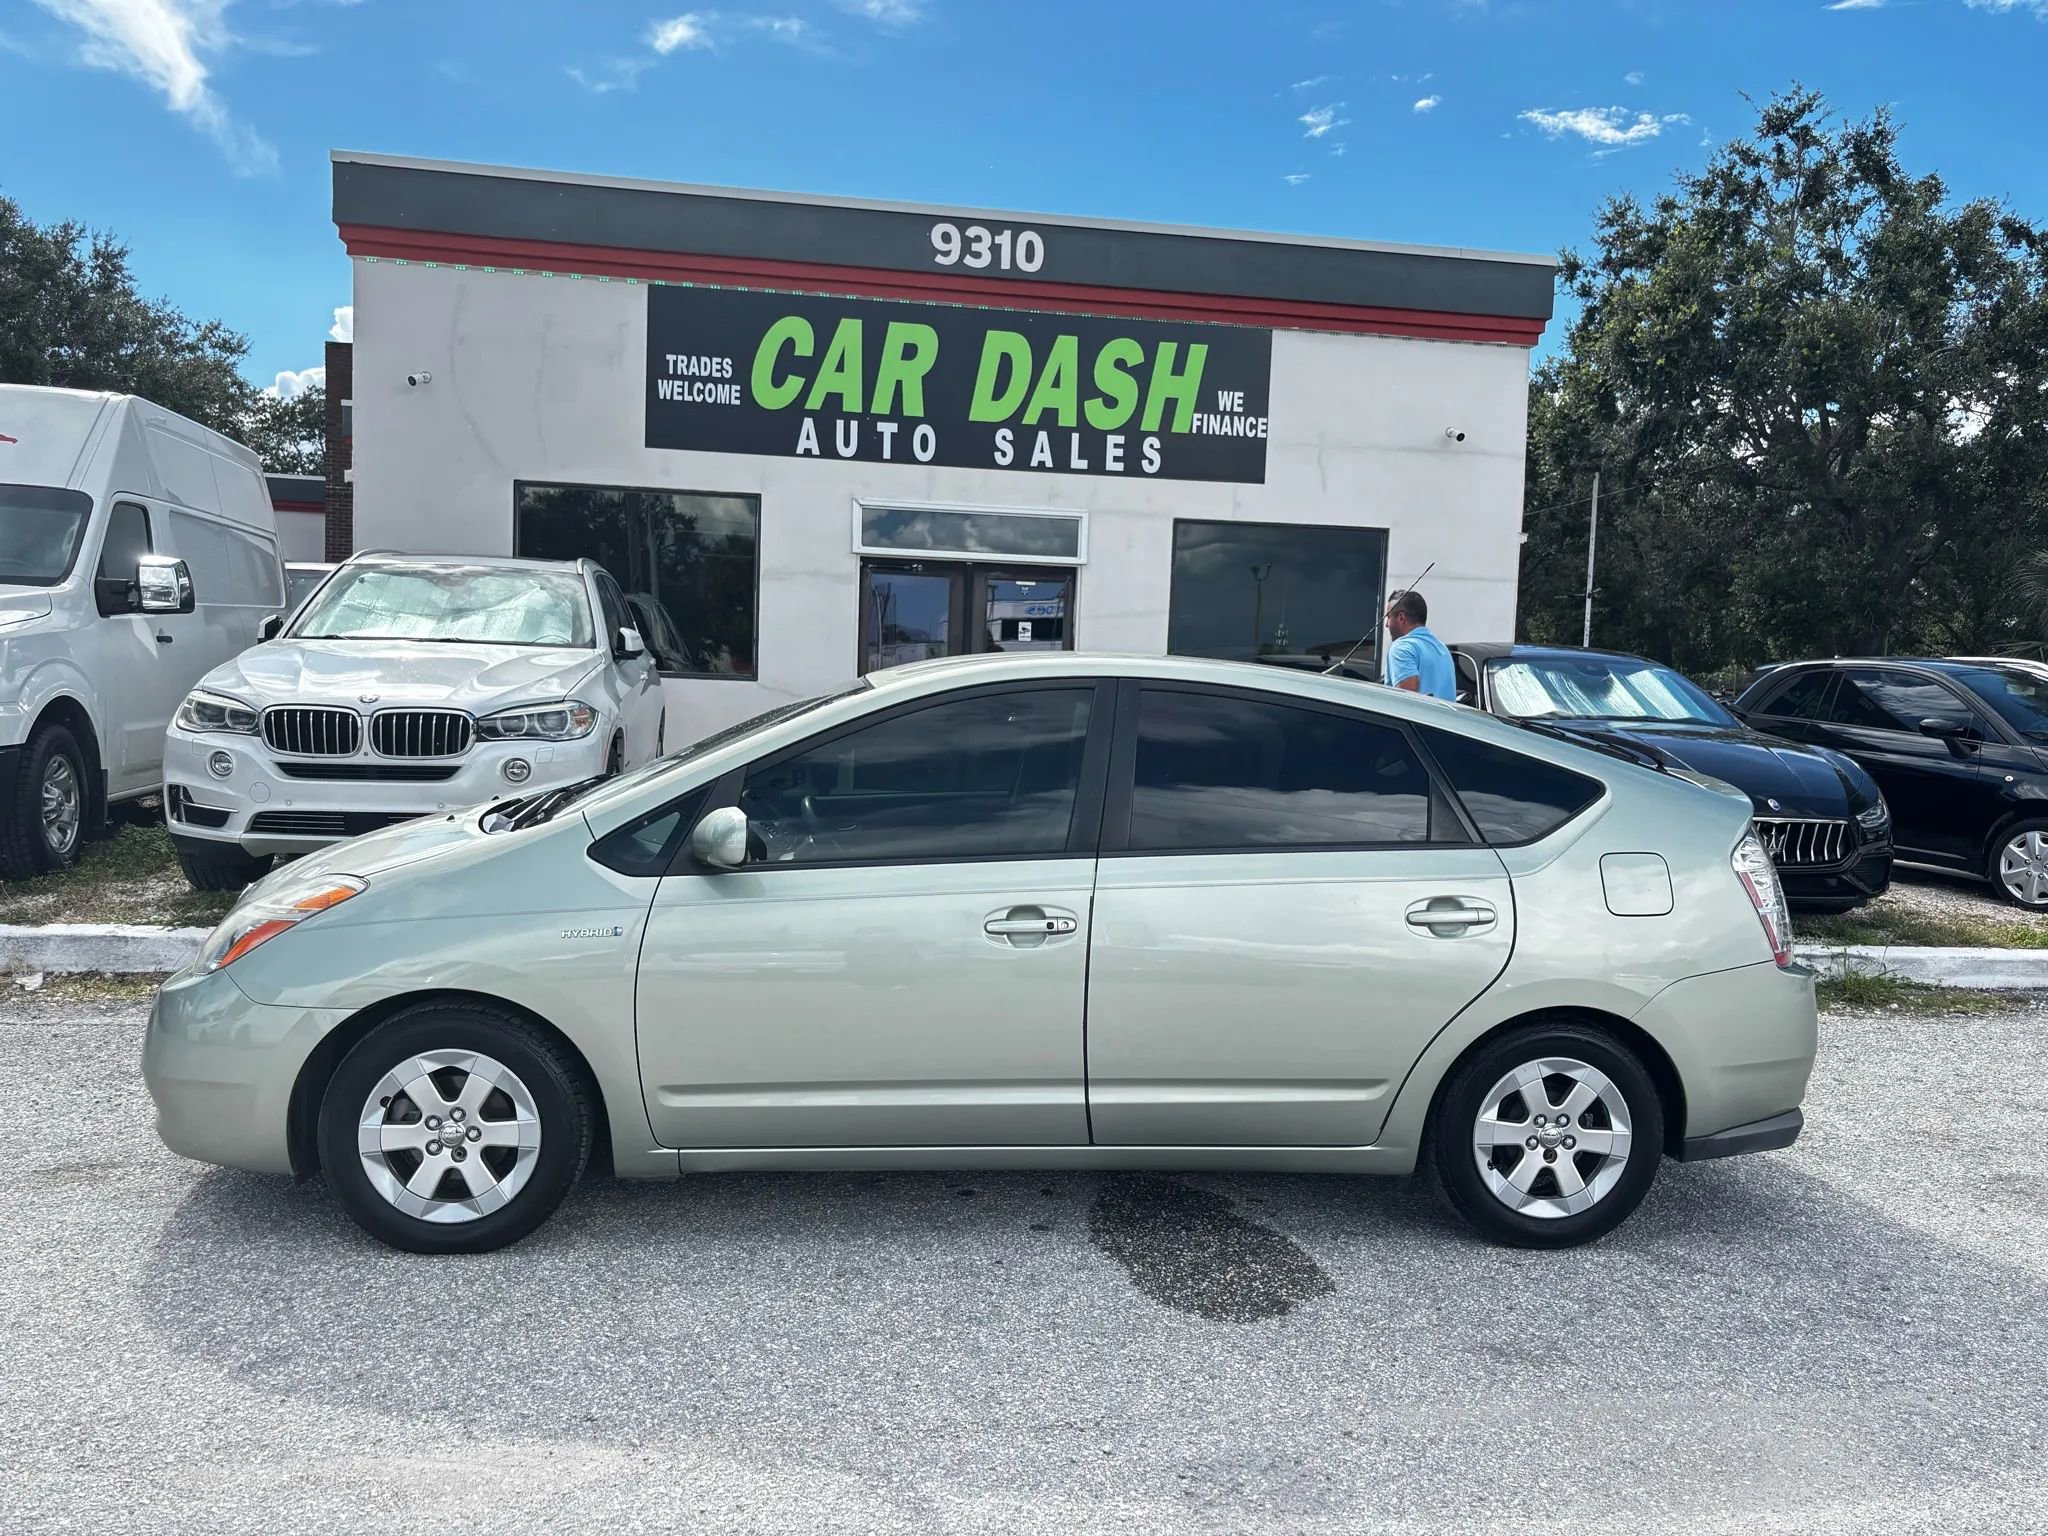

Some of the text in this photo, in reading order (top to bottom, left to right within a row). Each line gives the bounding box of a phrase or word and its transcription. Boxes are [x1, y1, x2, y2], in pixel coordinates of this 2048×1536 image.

[930, 223, 1045, 272] 9310
[665, 354, 733, 379] TRADES
[751, 316, 1208, 433] CAR DASH
[657, 379, 741, 405] WELCOME
[1217, 390, 1244, 413] WE
[1191, 412, 1268, 439] FINANCE
[795, 417, 1162, 474] AUTO SALES
[560, 928, 614, 939] HYBRID
